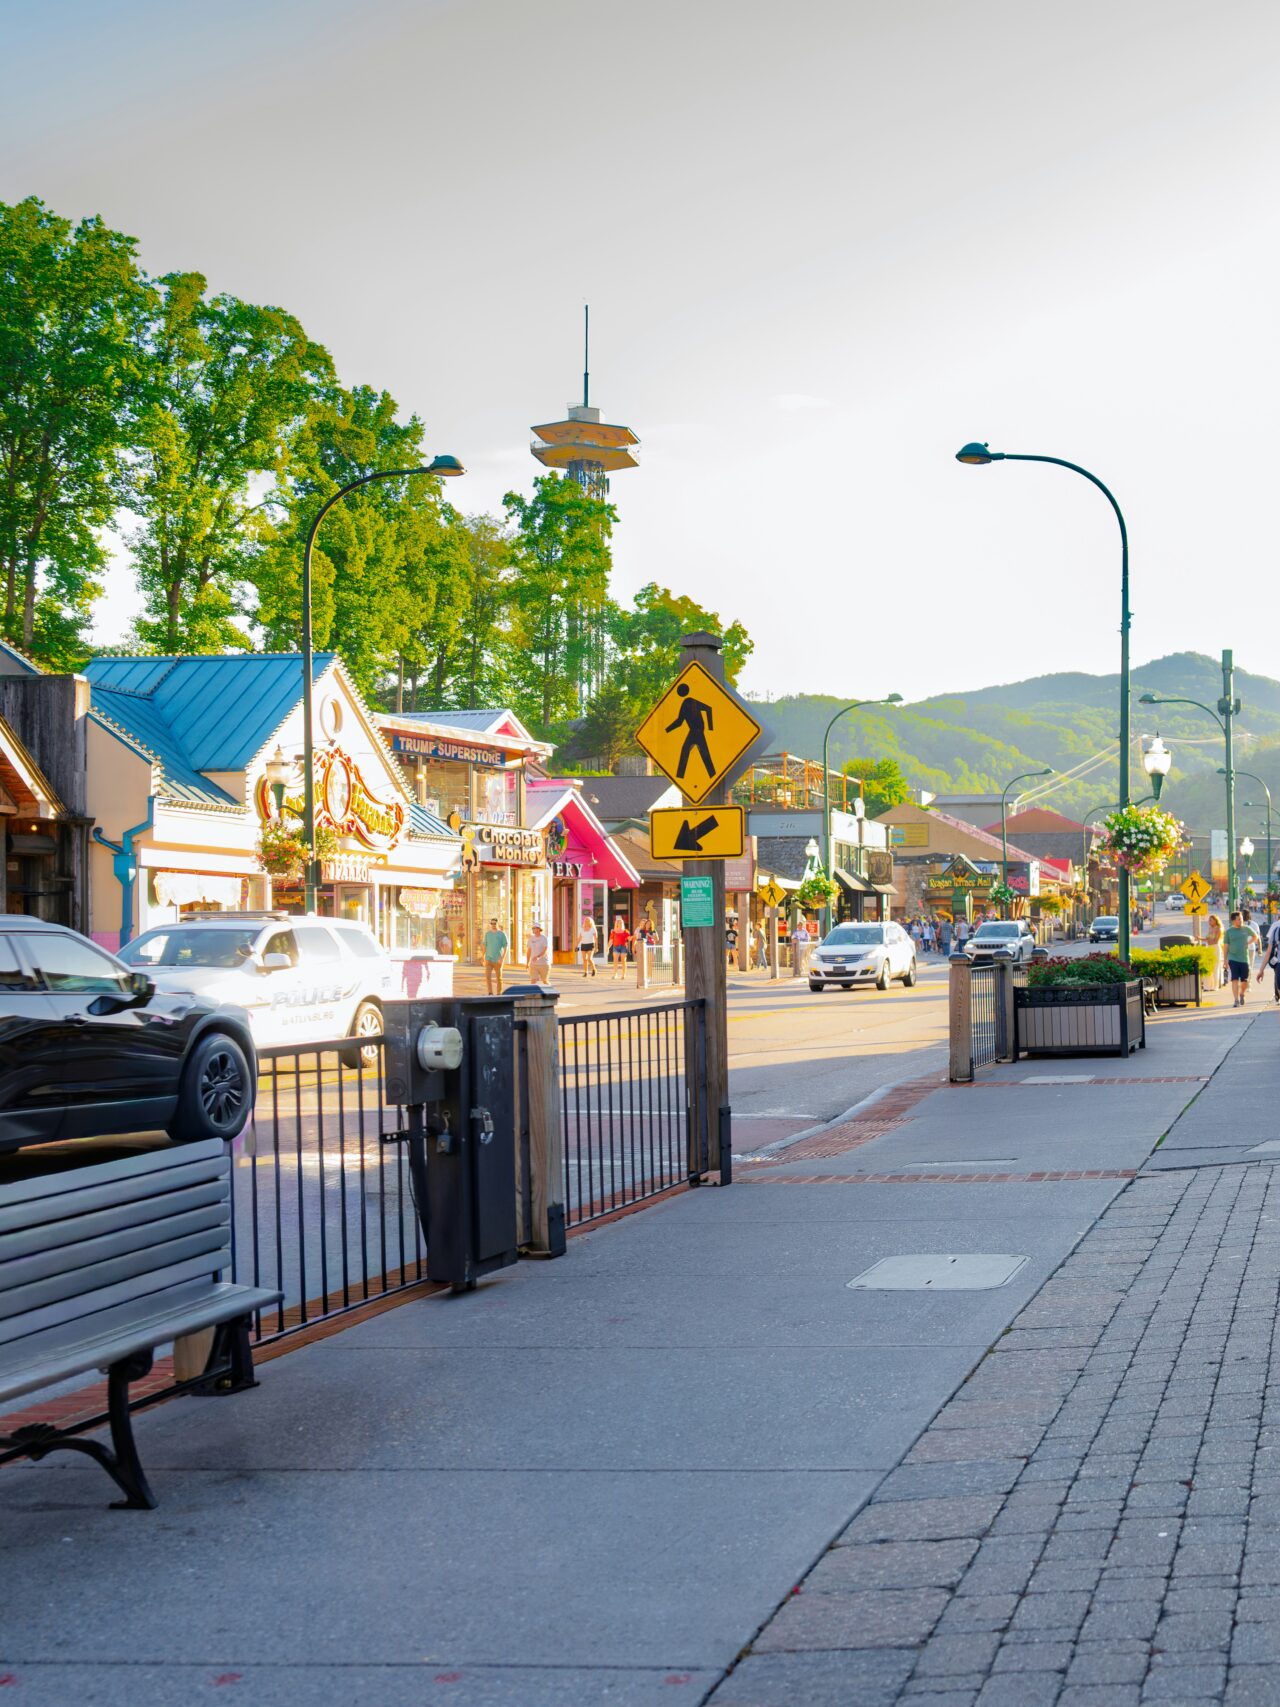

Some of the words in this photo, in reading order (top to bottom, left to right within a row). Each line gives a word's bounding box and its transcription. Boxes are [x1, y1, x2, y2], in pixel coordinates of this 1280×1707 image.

[399, 736, 435, 754] TRUMP
[438, 742, 501, 764] SUPERSTORE
[479, 827, 544, 847] Chocolate
[494, 845, 543, 865] Monkey
[270, 985, 343, 1011] POLICE
